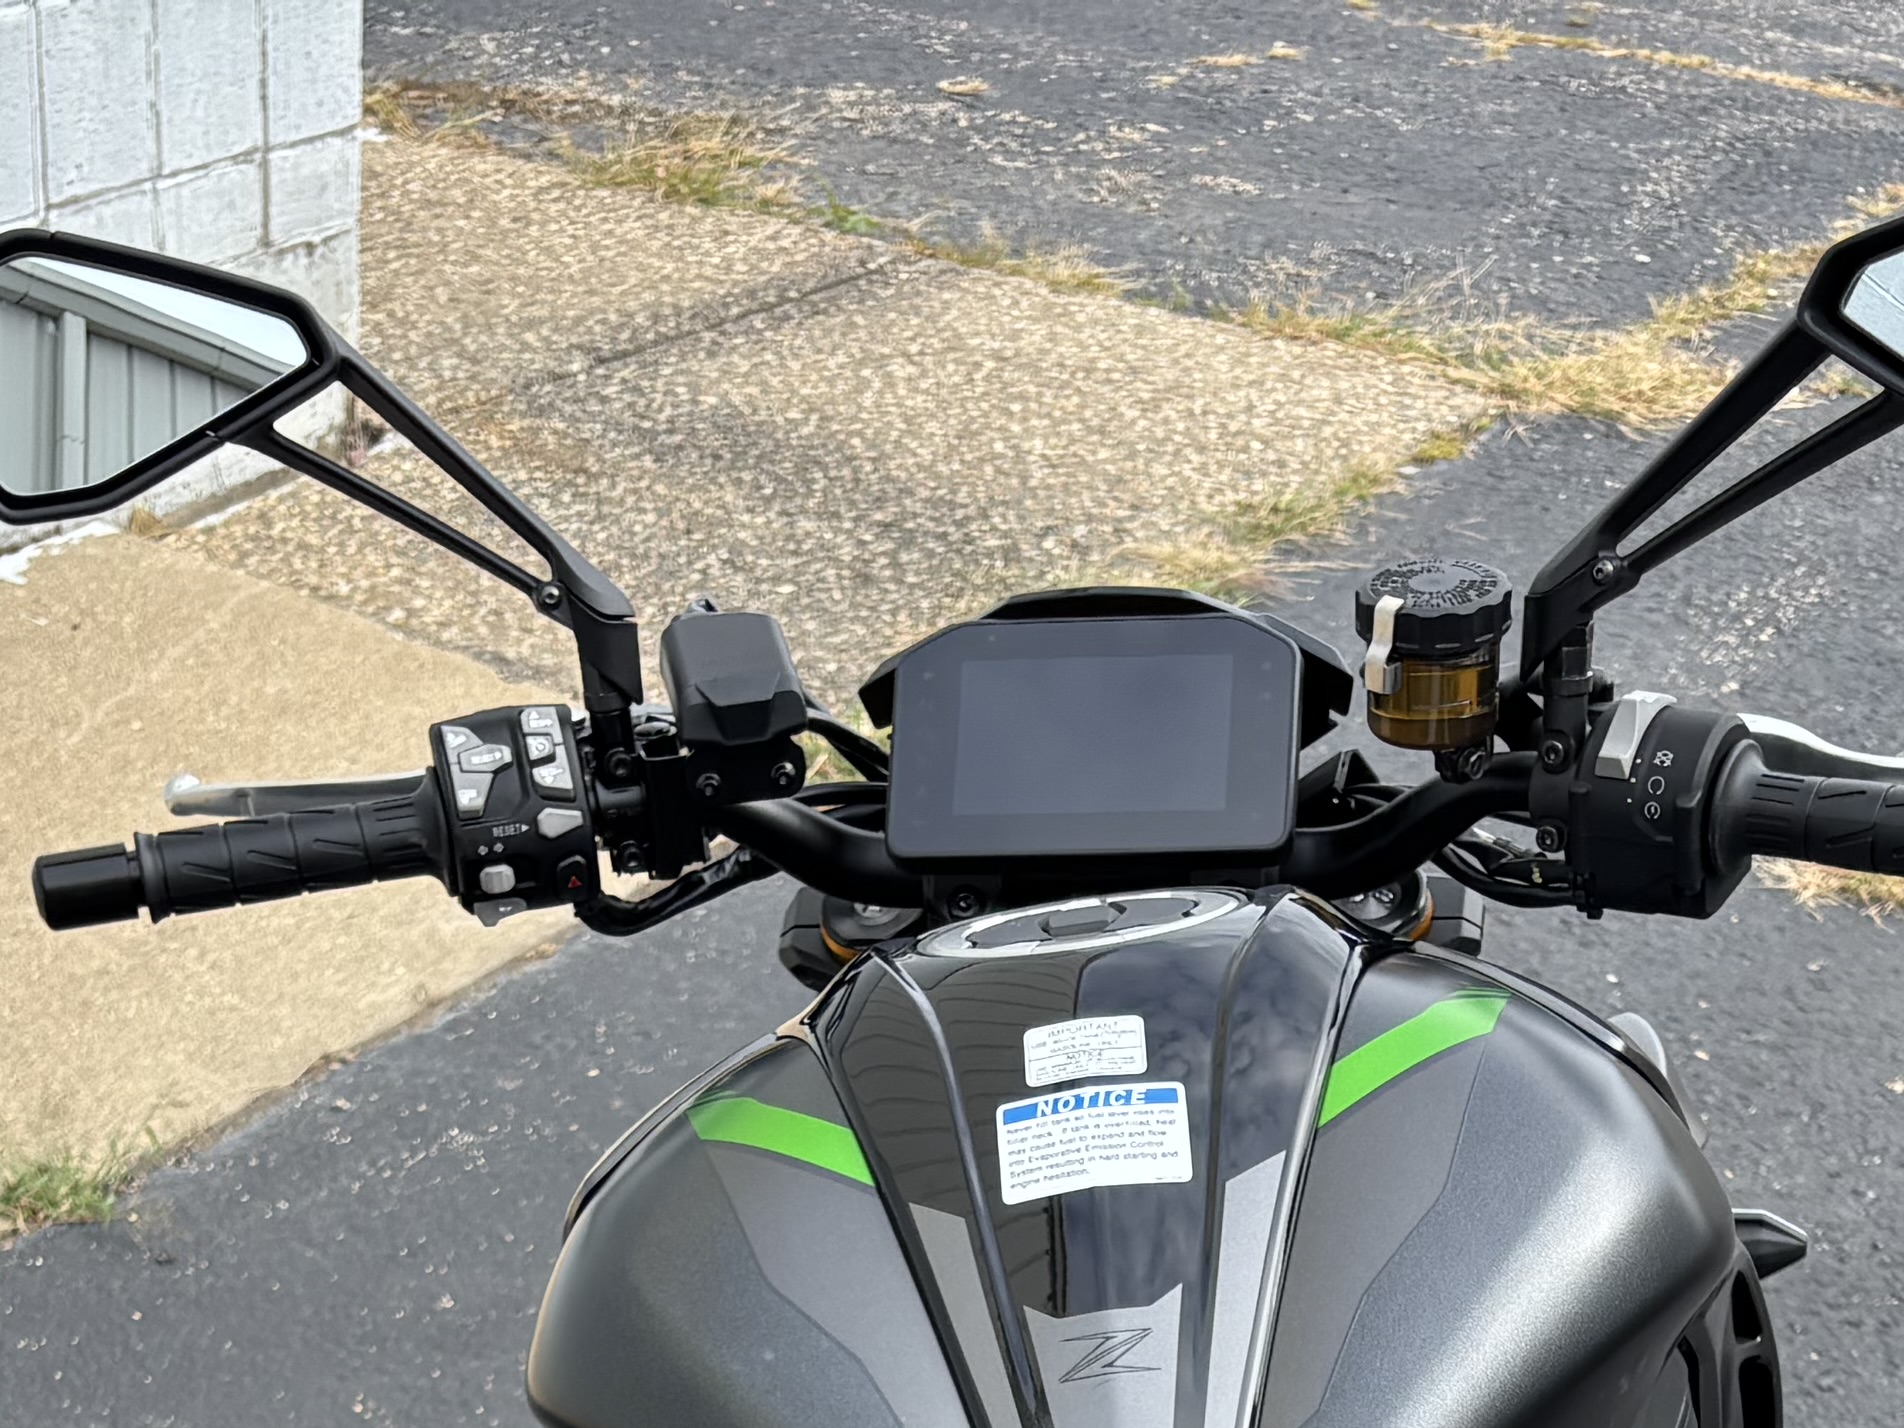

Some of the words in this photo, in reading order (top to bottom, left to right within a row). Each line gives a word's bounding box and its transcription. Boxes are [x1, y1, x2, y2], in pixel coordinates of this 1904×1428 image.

[493, 823, 520, 837] RESET
[1036, 1089, 1147, 1118] NOTICE
[1051, 1117, 1070, 1125] tank
[1071, 1124, 1089, 1133] tank
[1028, 1147, 1081, 1163] Evaporative
[1085, 1142, 1126, 1152] Emission
[1130, 1140, 1164, 1148] Control
[1030, 1141, 1056, 1152] cause
[1059, 1137, 1076, 1145] fuel
[1091, 1131, 1124, 1140] expand
[1128, 1128, 1145, 1137] and
[1010, 1166, 1043, 1179] System
[1046, 1157, 1085, 1170] resulting
[1099, 1153, 1120, 1161] hard
[1123, 1152, 1157, 1160] starting
[1161, 1150, 1178, 1158] and
[1010, 1178, 1040, 1189] engine
[1043, 1168, 1091, 1181] hesitation.
[1058, 1327, 1162, 1384] Z
